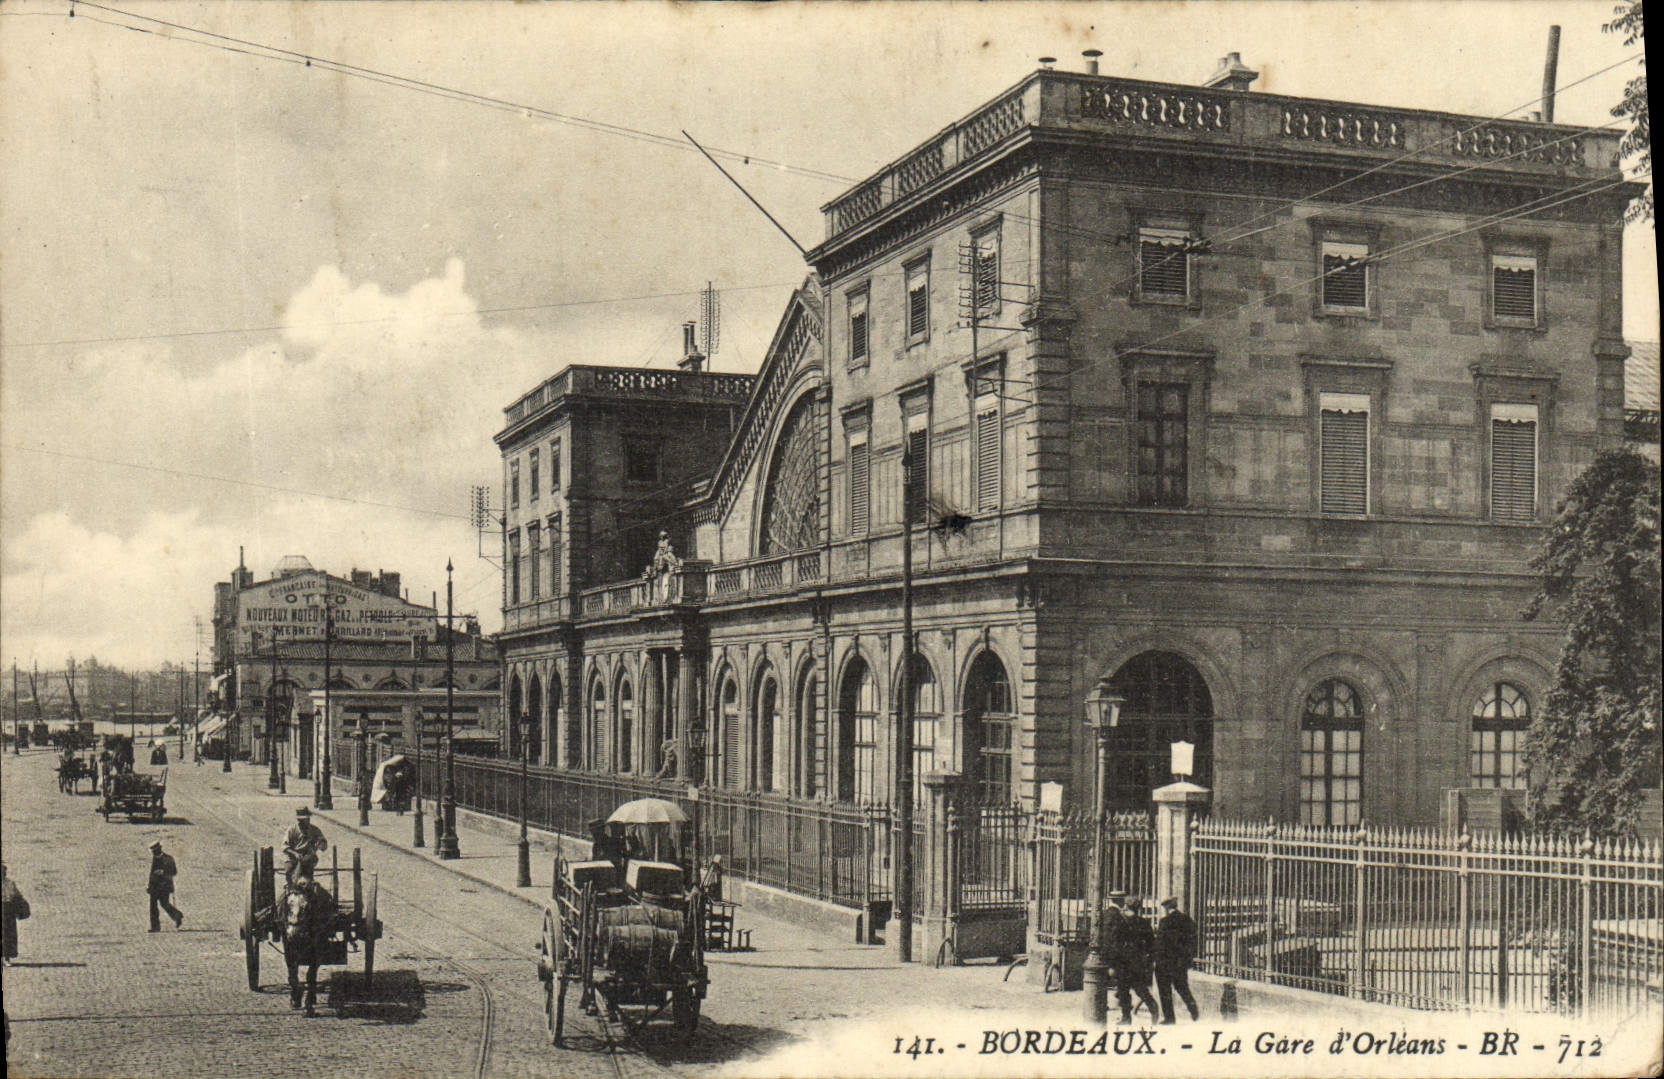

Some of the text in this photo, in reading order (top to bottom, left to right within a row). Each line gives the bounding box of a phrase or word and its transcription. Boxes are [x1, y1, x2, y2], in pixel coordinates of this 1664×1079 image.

[285, 593, 347, 605] OTTO
[246, 607, 288, 622] NOUVEAUX
[291, 607, 333, 622] MOTEUR
[334, 608, 352, 623] GAZ
